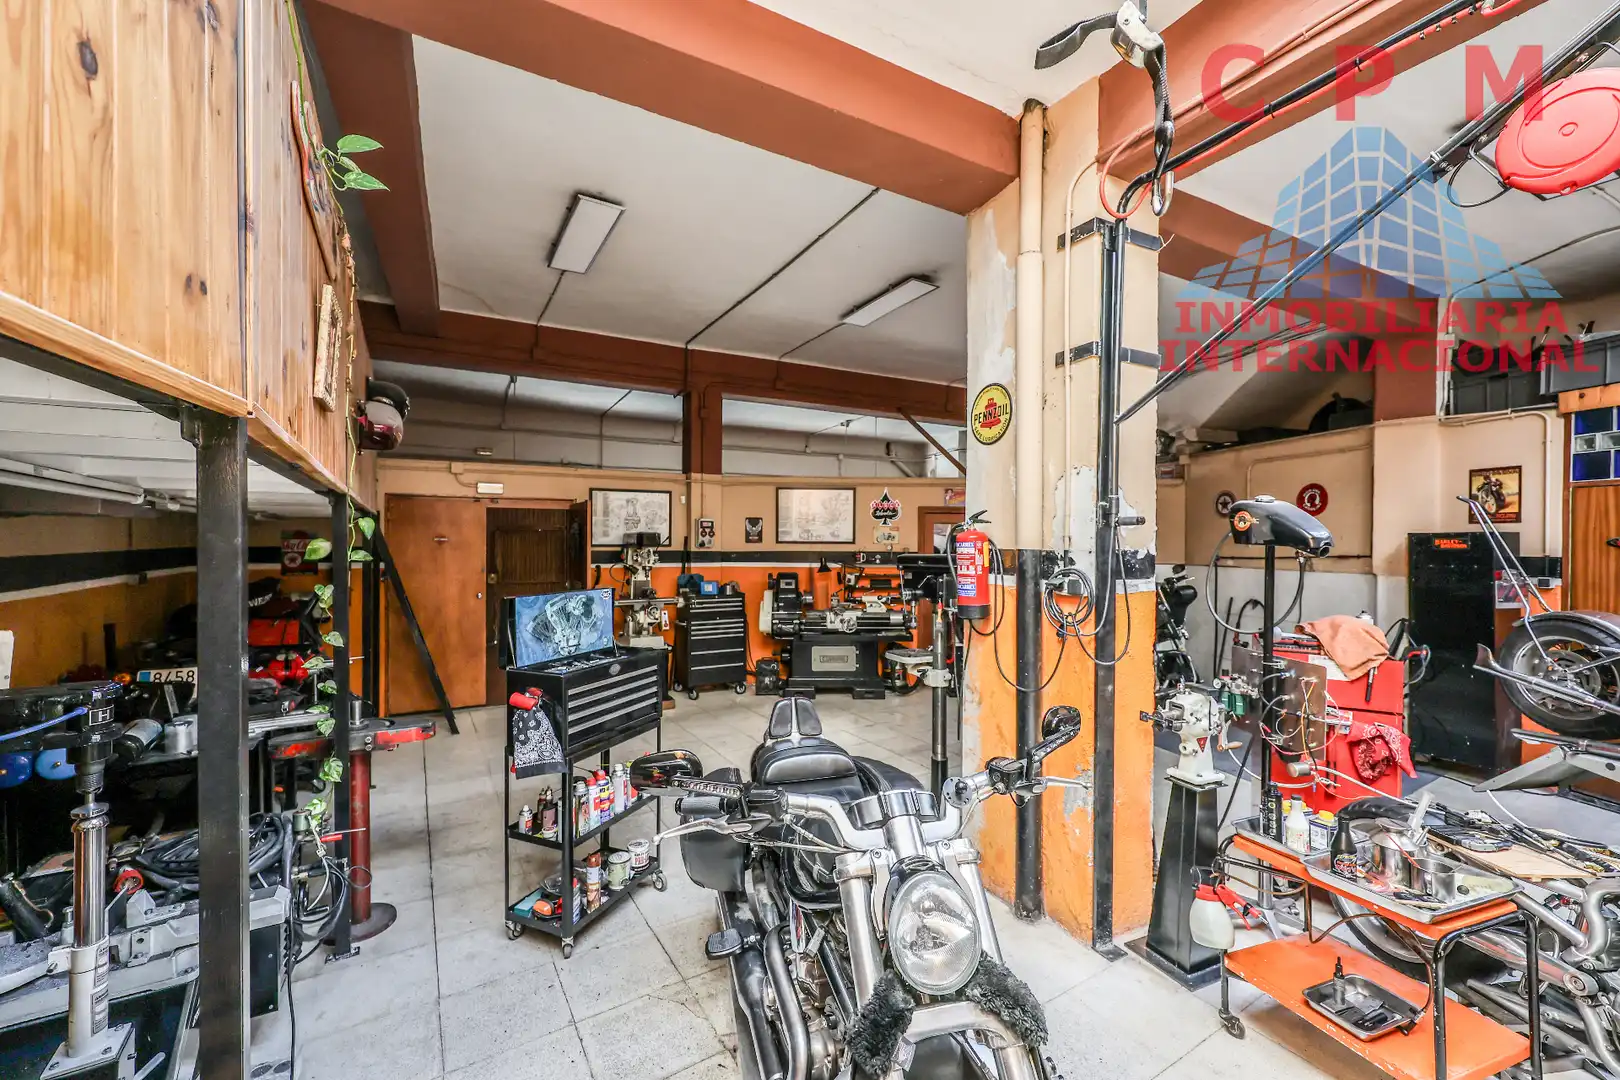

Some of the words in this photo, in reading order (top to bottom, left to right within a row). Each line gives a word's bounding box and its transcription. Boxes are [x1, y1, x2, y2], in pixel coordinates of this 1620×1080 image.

[973, 402, 1009, 426] PENNZOIL
[153, 670, 196, 683] 8458
[98, 709, 110, 722] H
